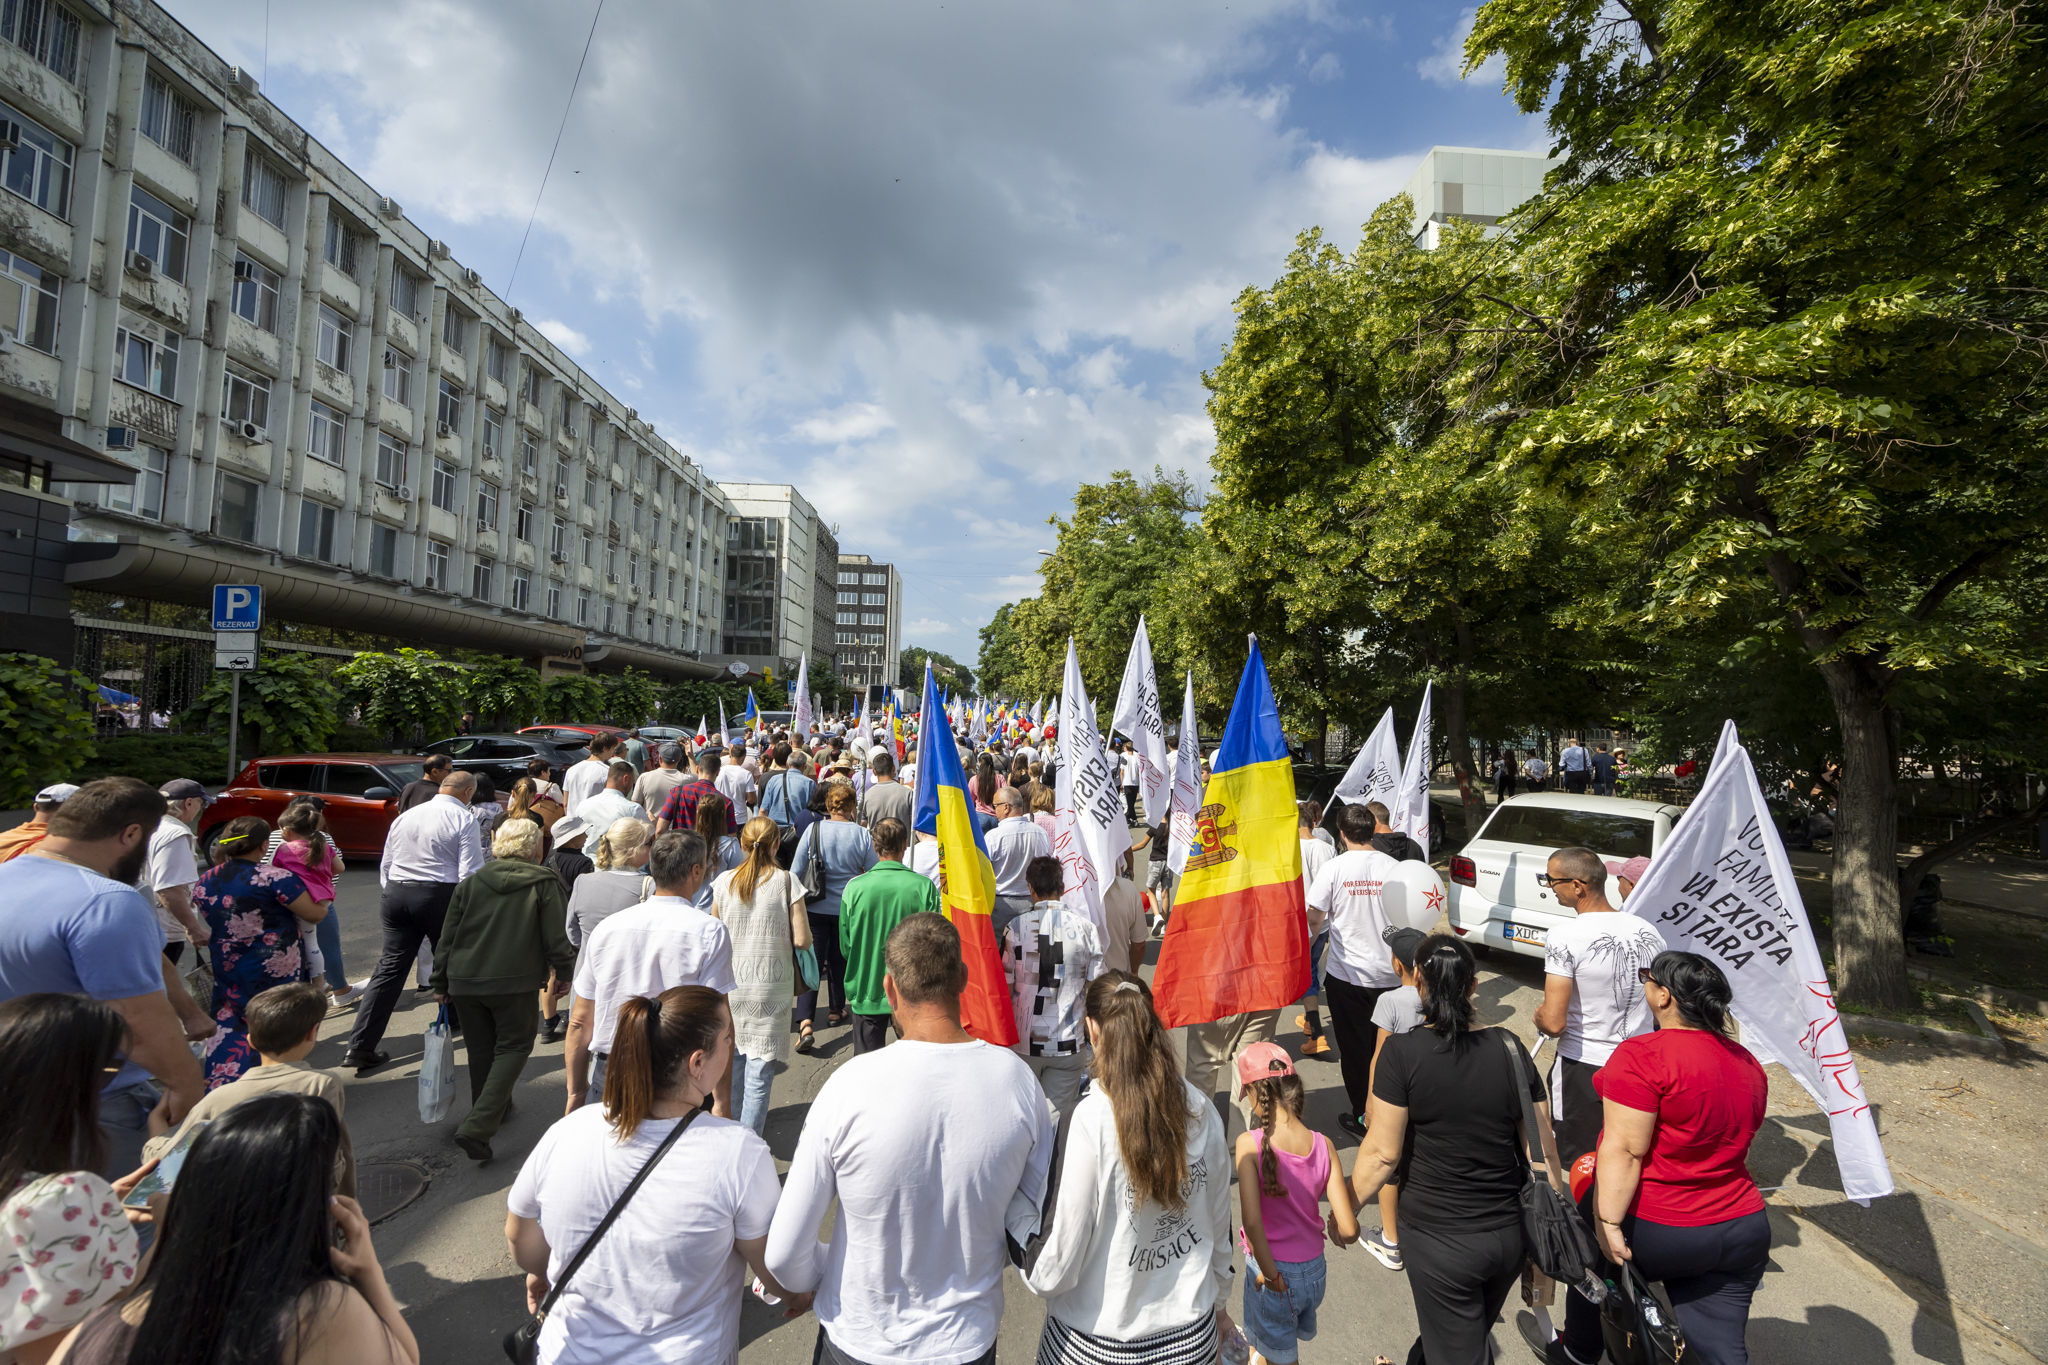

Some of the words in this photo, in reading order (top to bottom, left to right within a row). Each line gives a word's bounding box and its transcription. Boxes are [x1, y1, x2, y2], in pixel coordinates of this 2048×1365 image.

[226, 588, 251, 620] P
[1515, 926, 1539, 940] XDC
[1680, 871, 1718, 901] VA
[1708, 892, 1793, 966] EXISTA
[1129, 1224, 1202, 1272] VERSACE
